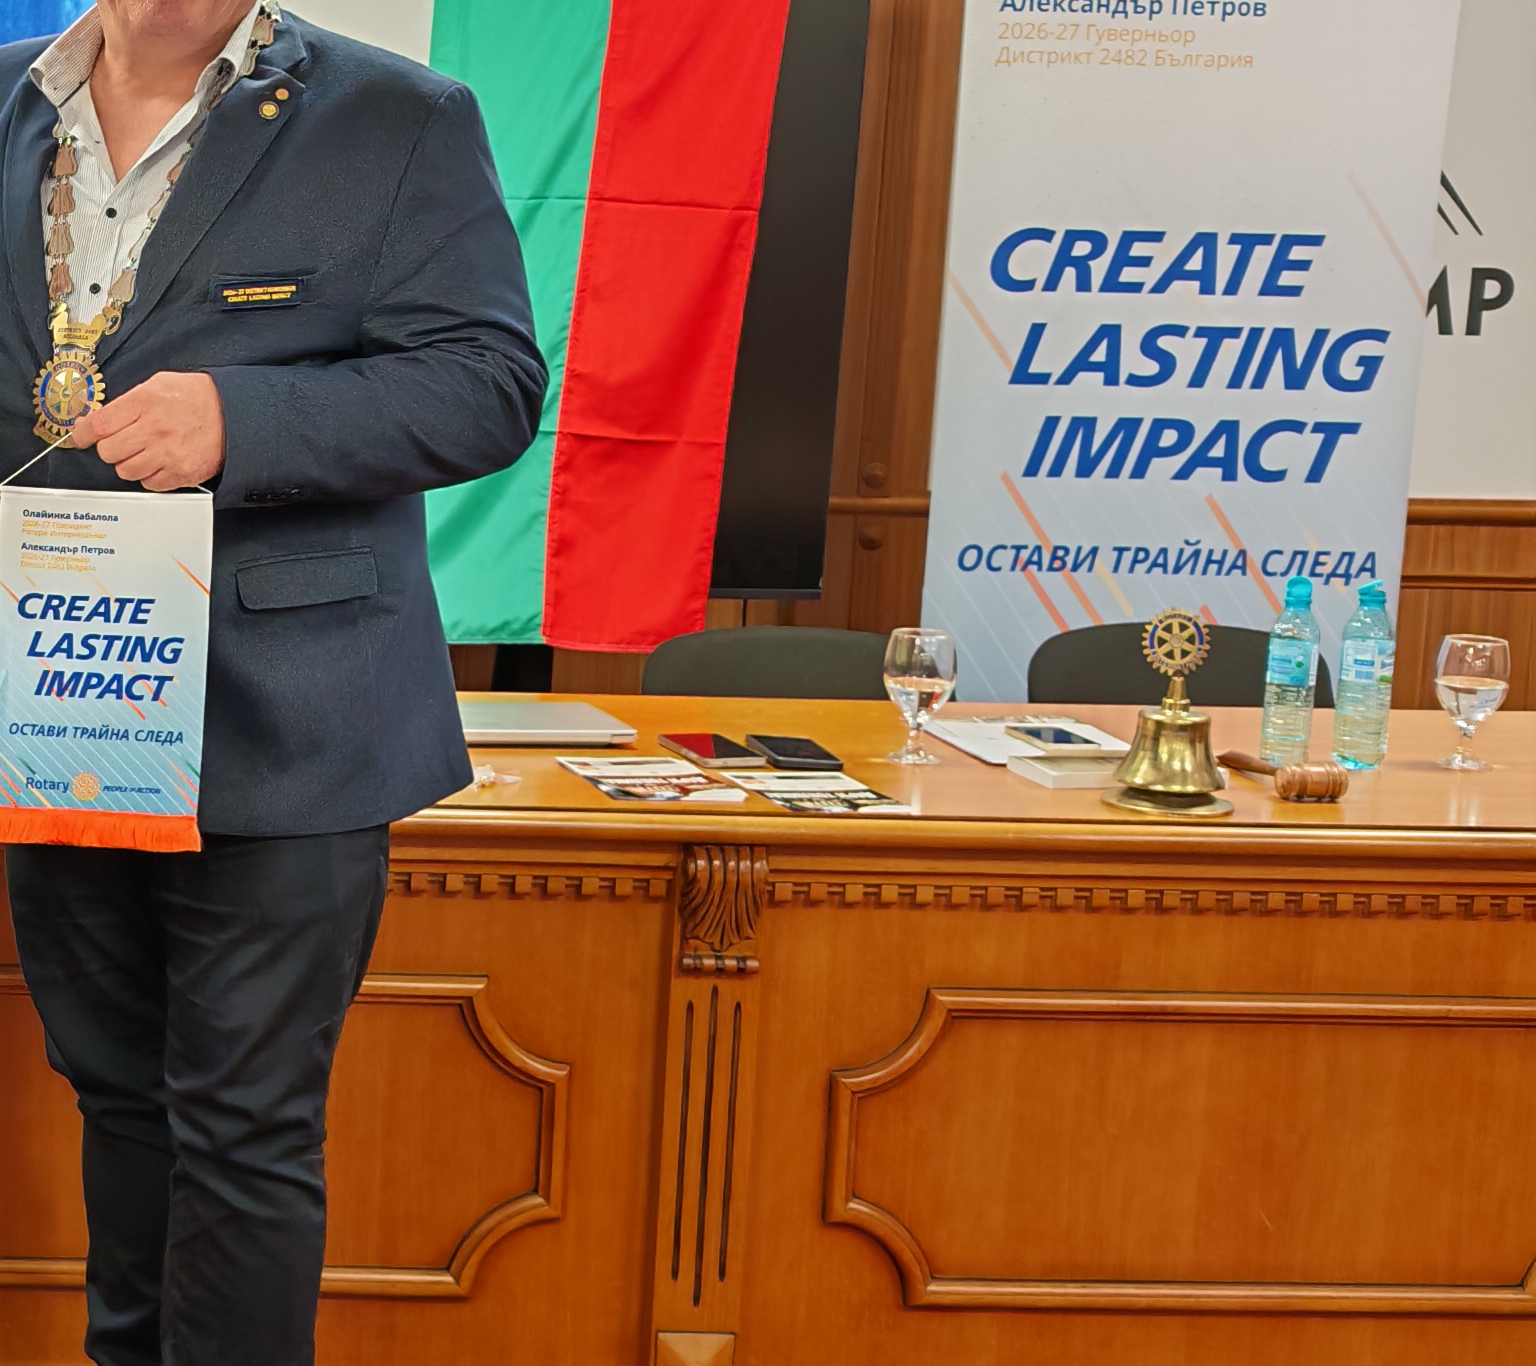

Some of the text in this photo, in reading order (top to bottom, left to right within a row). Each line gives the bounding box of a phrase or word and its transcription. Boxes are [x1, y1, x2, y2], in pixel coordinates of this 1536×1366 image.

[997, 22, 1196, 46] 2026-27 Гуверньор
[994, 47, 1254, 71] Дистрикт 2482 България
[989, 227, 1326, 298] CREATE
[1007, 322, 1392, 393] LASTING
[1021, 415, 1363, 484] IMPACT
[22, 509, 119, 522] Олайинка Бабалола
[21, 542, 115, 556] Александър Петров
[957, 538, 1378, 586] ОСТАВИ ТРАЙНА СЛЕДА
[17, 592, 156, 624] CREATE
[26, 630, 185, 664] LASTING
[34, 669, 175, 702] IMPACT
[9, 722, 184, 746] ОСТАВИ ТРАЙНА СЛЕДА
[25, 777, 70, 793] Rotary
